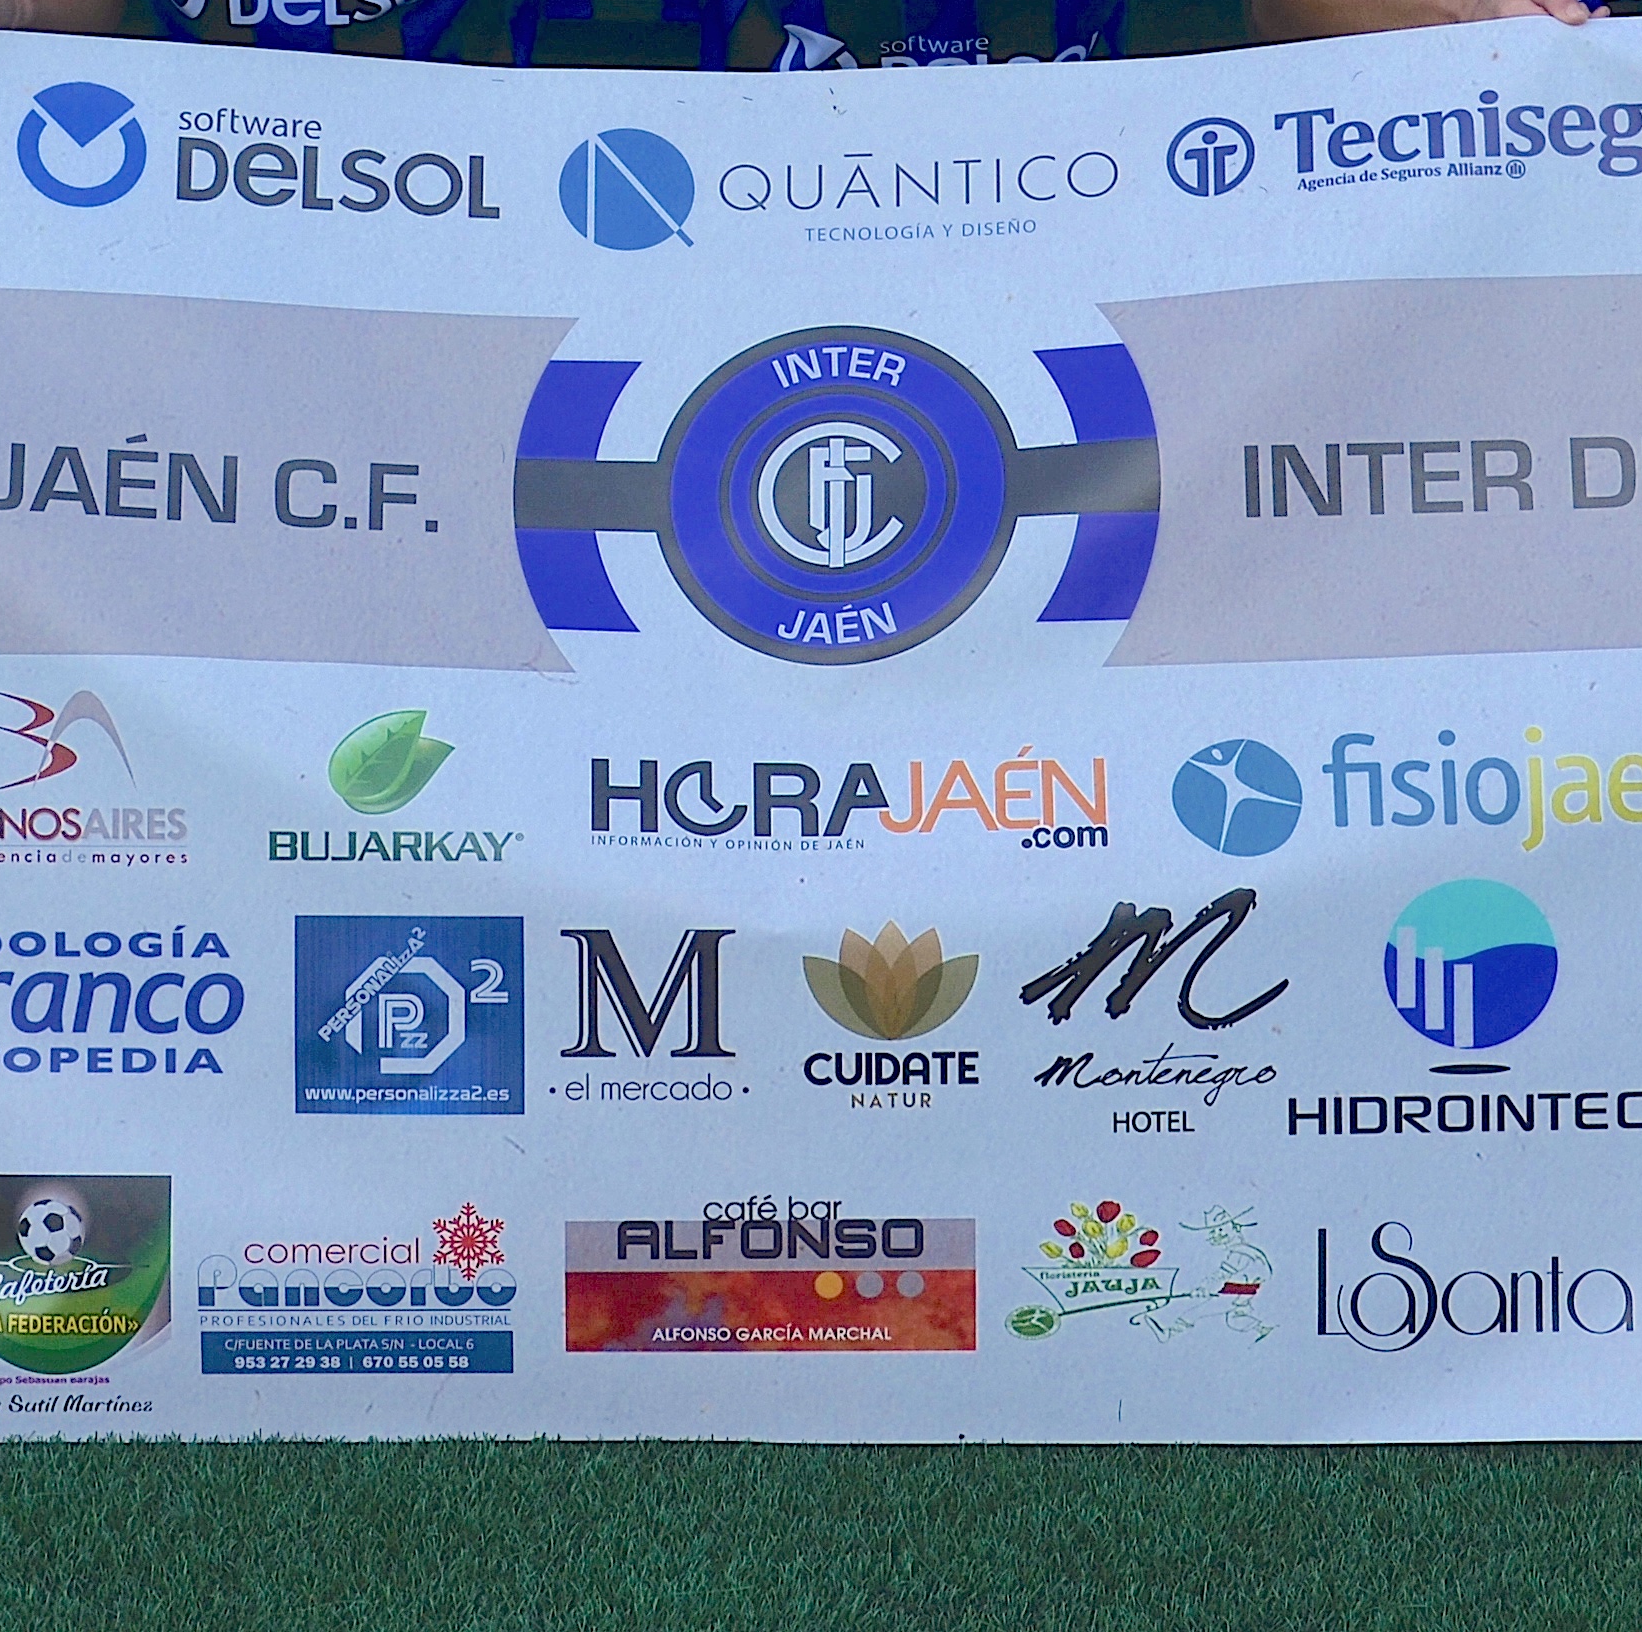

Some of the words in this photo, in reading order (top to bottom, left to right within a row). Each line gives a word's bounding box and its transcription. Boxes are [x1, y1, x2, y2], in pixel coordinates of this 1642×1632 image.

[880, 35, 989, 54] software
[177, 105, 322, 141] software
[1297, 172, 1358, 192] Agencia
[1359, 169, 1378, 183] de
[1380, 166, 1442, 183] Seguros
[1446, 162, 1503, 178] Allianz
[805, 223, 936, 242] TECNOLOGÍA
[941, 224, 955, 239] Y
[962, 218, 1037, 238] DISEÑO
[770, 344, 909, 390] INTER
[1244, 436, 1536, 520] INTER
[273, 457, 441, 534] C.F.
[776, 601, 898, 646] JAÉN
[590, 835, 704, 849] INFORMACIÓN
[710, 838, 719, 849] Y
[725, 836, 794, 852] OPINIÓN
[800, 839, 820, 852] DE
[826, 837, 866, 851] JAÉN
[560, 928, 736, 1059] M
[803, 1050, 981, 1087] CUIDATE
[1034, 1043, 1278, 1106] Montenegro
[304, 1085, 510, 1104] www.personalizza2.es
[566, 1076, 594, 1102] el
[601, 1074, 734, 1103] mercado
[850, 1091, 934, 1109] NATUR
[1112, 1109, 1196, 1134] HOTEL
[702, 1194, 779, 1224] café
[788, 1195, 843, 1223] bar
[244, 1236, 421, 1265] comercial
[617, 1218, 925, 1260] ALFONSO
[1064, 1276, 1163, 1299] JAUJA
[200, 1314, 346, 1327] PROFESIONALES
[352, 1314, 378, 1327] DEL
[430, 1314, 512, 1327] INDUSTRIAL
[651, 1326, 733, 1344] ALFONSO
[735, 1322, 804, 1344] GARCÍA
[808, 1324, 892, 1343] MARCHAL
[224, 1338, 291, 1352] C/FUENTE
[294, 1338, 312, 1351] DE
[316, 1338, 333, 1351] LA
[336, 1338, 379, 1351] PLATA
[418, 1338, 463, 1351] LOCAL
[466, 1338, 475, 1351] 6
[234, 1355, 266, 1370] 953
[270, 1355, 291, 1370] 27
[294, 1355, 317, 1370] 29
[319, 1355, 341, 1370] 38
[362, 1355, 394, 1370] 670
[397, 1355, 419, 1370] 55
[422, 1355, 445, 1370] 05
[448, 1355, 470, 1370] 58
